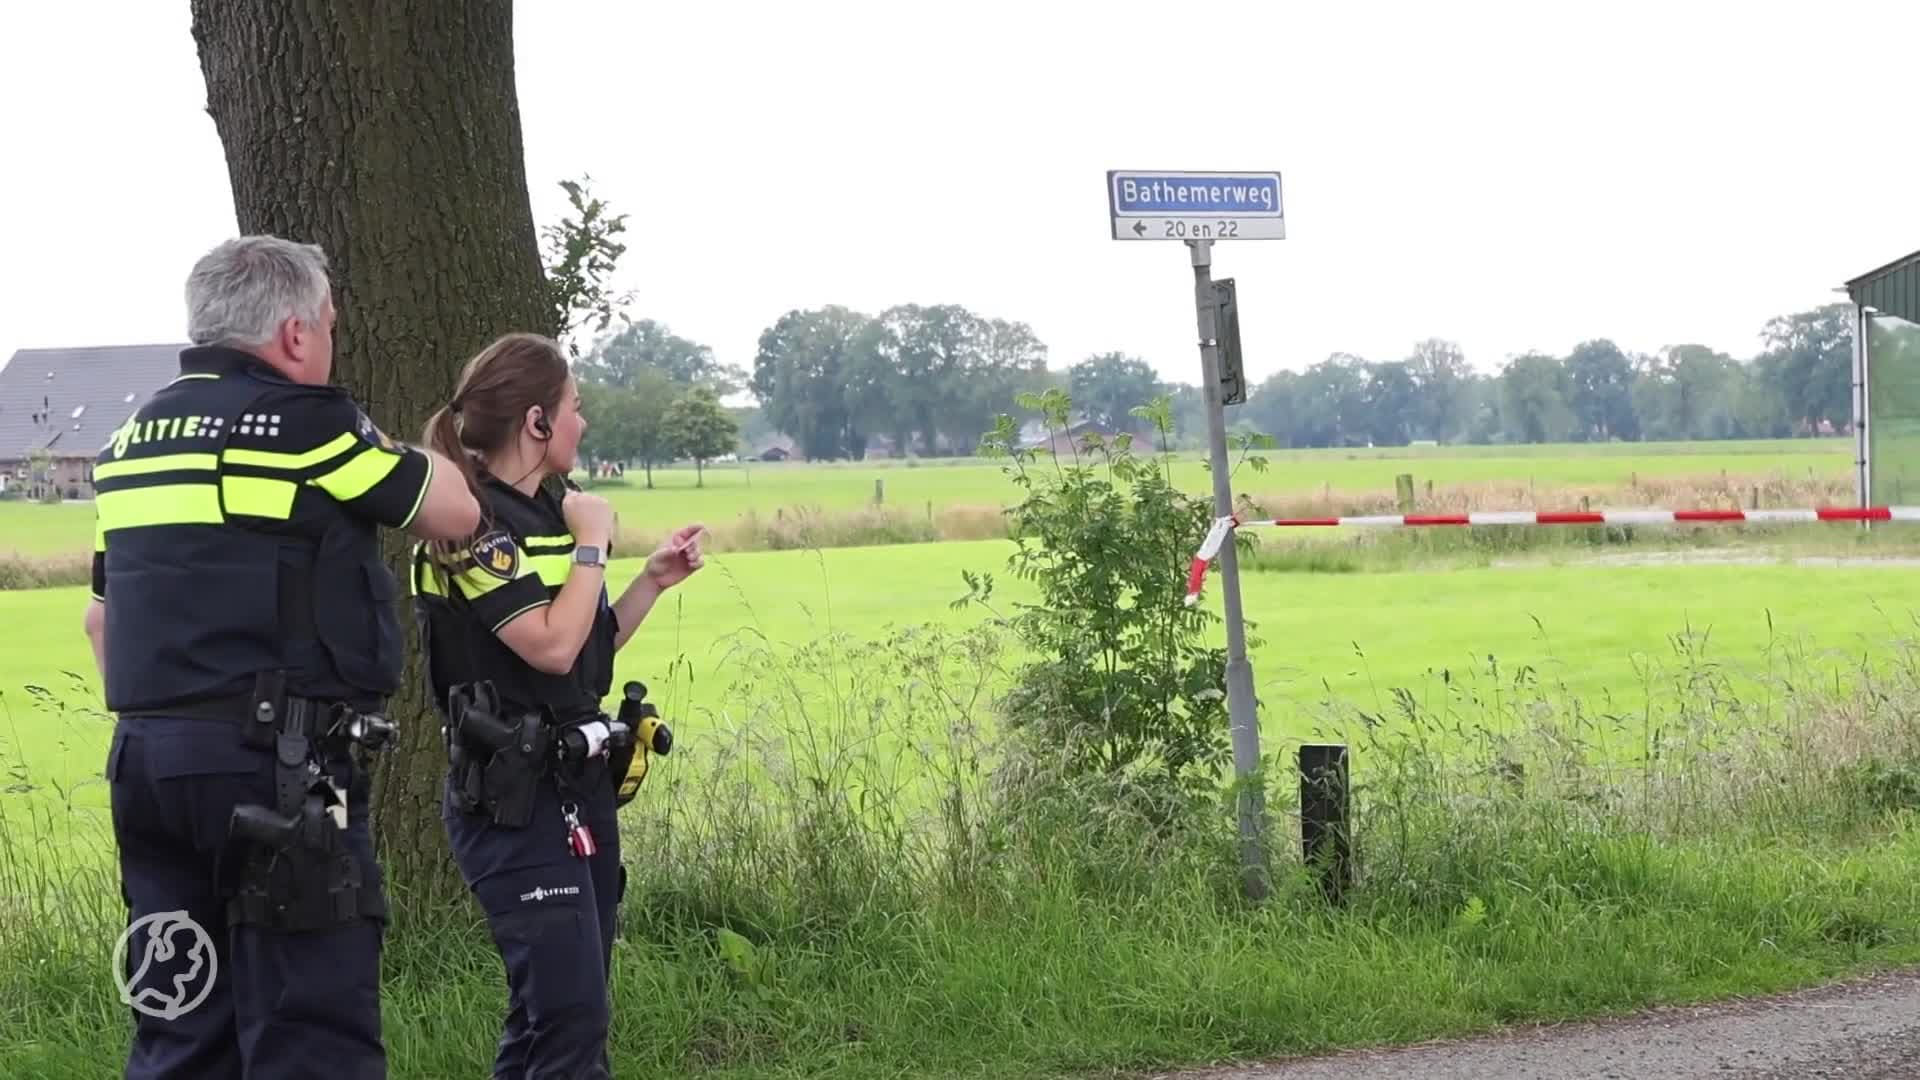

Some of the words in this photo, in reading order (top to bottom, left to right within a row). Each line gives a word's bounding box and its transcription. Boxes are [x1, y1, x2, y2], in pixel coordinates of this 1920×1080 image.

[1123, 180, 1272, 210] Bathemerweg
[1165, 221, 1186, 237] 20
[1192, 224, 1211, 237] en
[1217, 221, 1238, 237] 22
